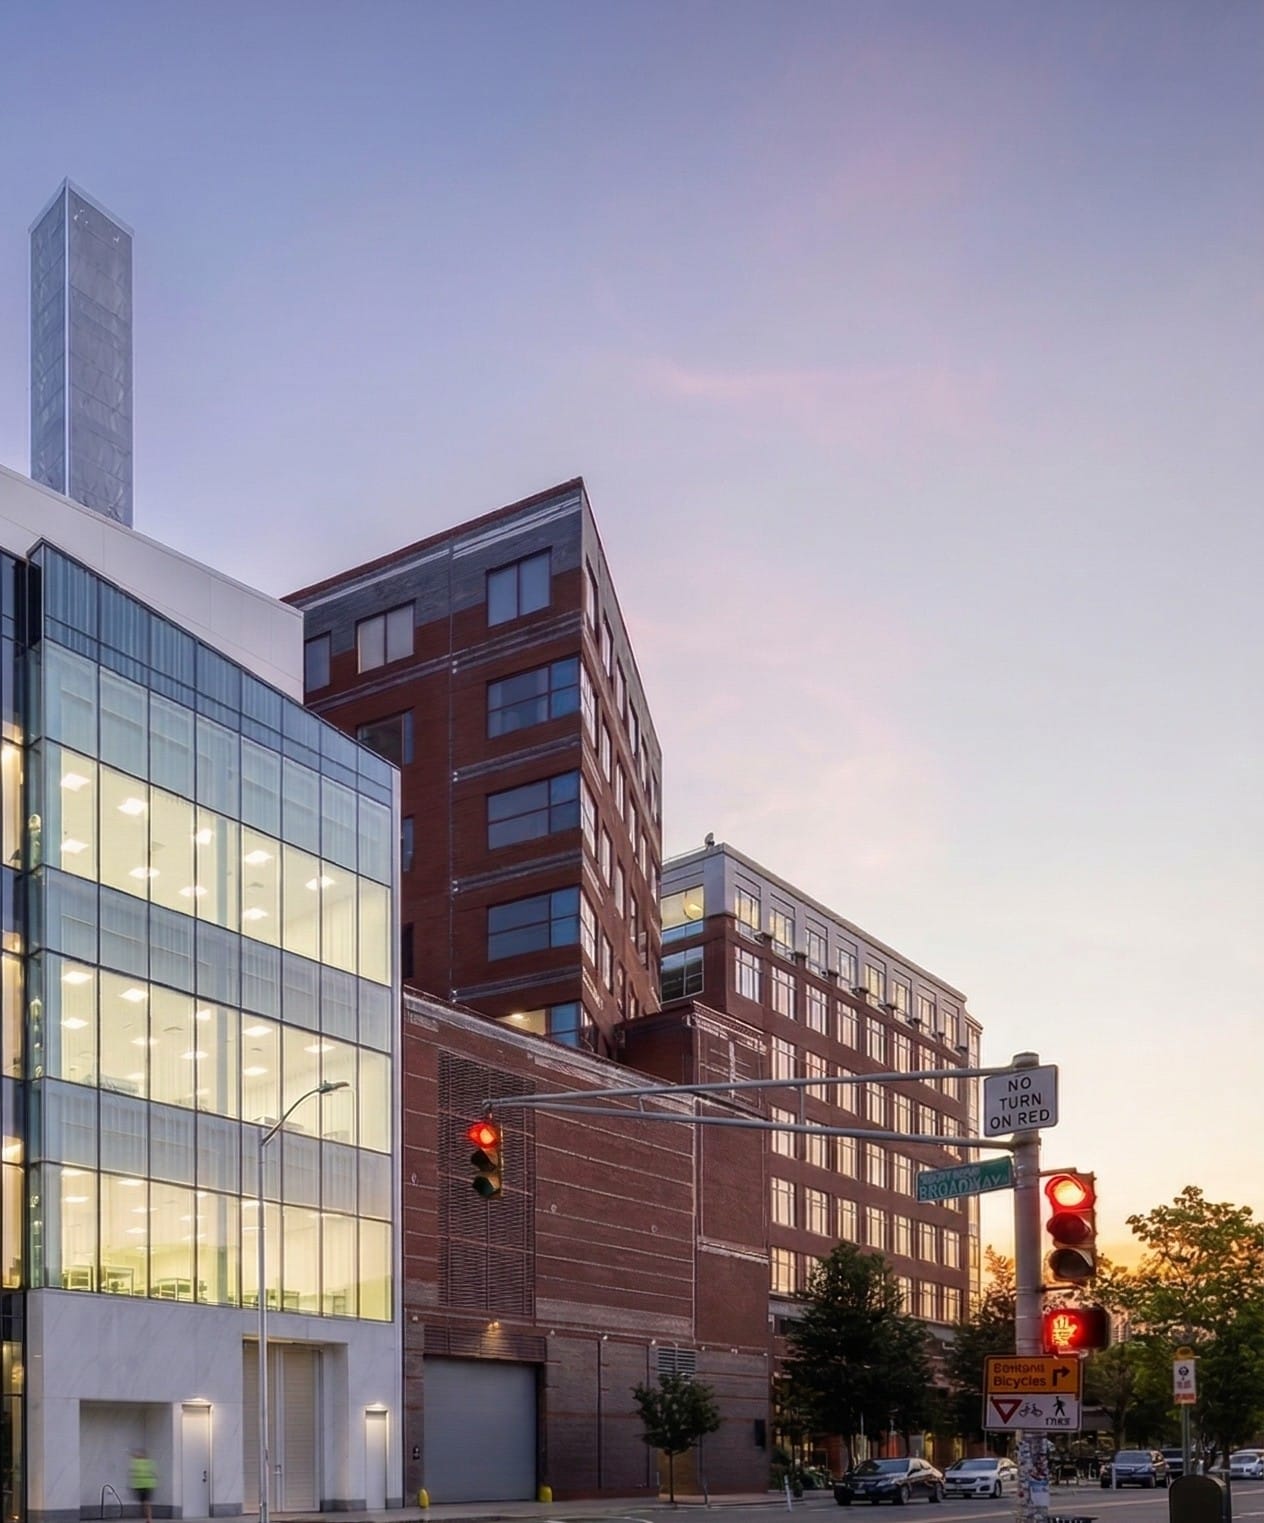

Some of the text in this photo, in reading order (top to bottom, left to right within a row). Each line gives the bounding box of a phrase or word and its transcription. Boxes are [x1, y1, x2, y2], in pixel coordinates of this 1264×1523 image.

[1008, 1077, 1032, 1092] NO
[999, 1093, 1042, 1111] TURN
[990, 1109, 1050, 1130] ON RED
[993, 1376, 1047, 1389] Bicycles
